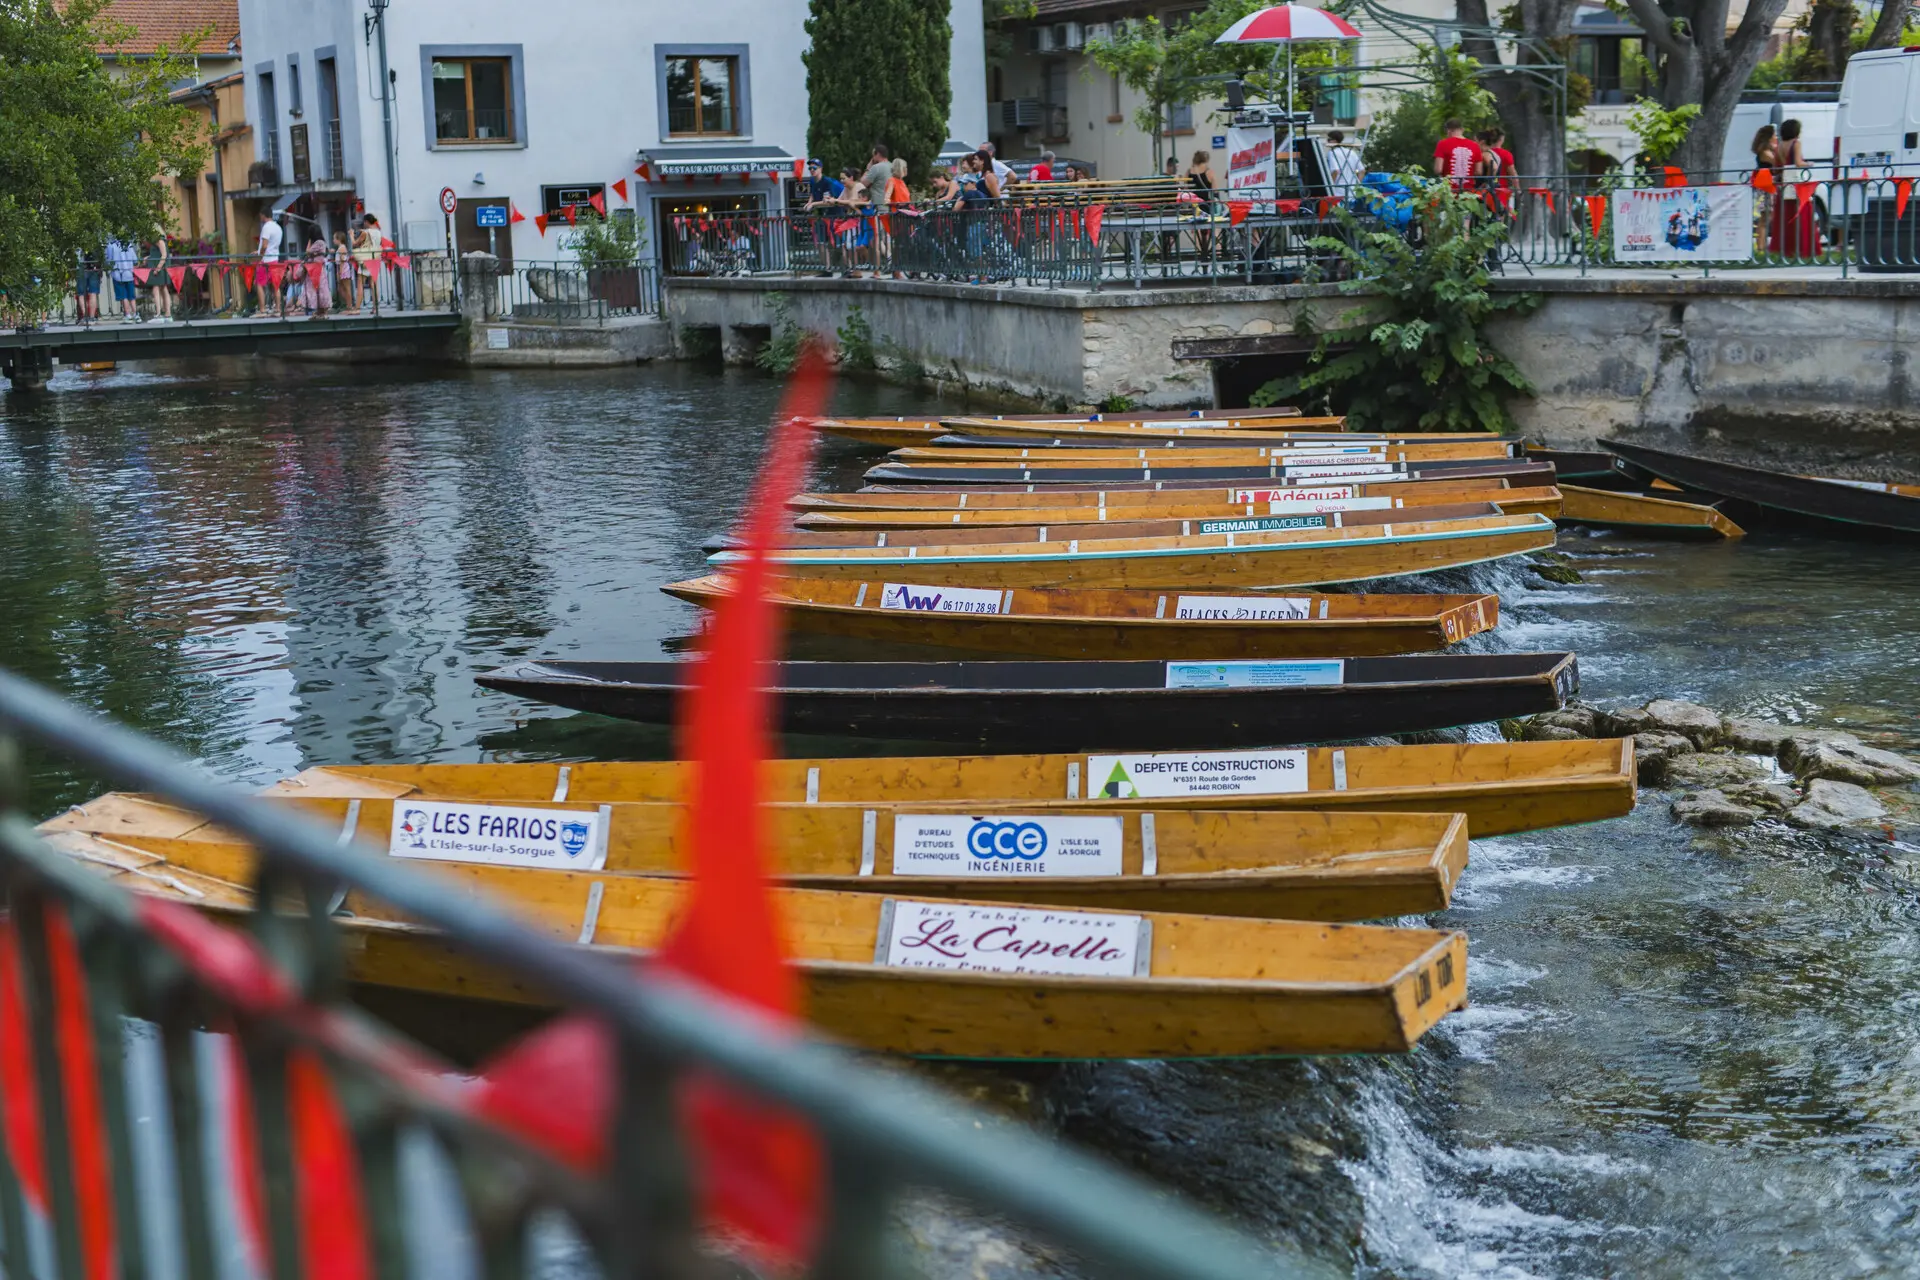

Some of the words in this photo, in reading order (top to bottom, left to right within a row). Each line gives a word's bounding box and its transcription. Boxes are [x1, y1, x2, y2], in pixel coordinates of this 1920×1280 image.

[750, 162, 792, 172] PLANCHE
[1292, 458, 1335, 466] TORRECILLAS
[1336, 456, 1377, 465] CHRISTOPHE
[1270, 488, 1348, 501] Adéquat
[1203, 519, 1259, 533] GERMAIN
[1262, 516, 1323, 530] IMMOBILIER
[943, 600, 952, 611] 06
[955, 601, 964, 612] 17
[965, 602, 974, 612] 01
[975, 602, 985, 613] 28
[987, 603, 996, 614] 98
[1180, 608, 1228, 620] BLACKS
[1134, 761, 1189, 774] DEPEYTE
[1191, 759, 1295, 772] CONSTRUCTIONS
[1221, 774, 1230, 782] de
[1231, 774, 1257, 782] Gordes
[1212, 783, 1240, 791] ROBION
[432, 812, 470, 835] LES
[478, 815, 557, 841] FARIOS
[918, 828, 952, 836] BUREAU
[915, 840, 954, 848] D'ETUDES
[1060, 838, 1082, 847] L'ISLE
[1083, 838, 1099, 847] SUR
[430, 839, 556, 858] L'Isle-sur-la-Sorgue
[1058, 848, 1069, 856] LA
[1070, 848, 1101, 857] SORGUE
[908, 852, 960, 861] TECHNIQUES
[920, 907, 955, 918] Bar
[1043, 914, 1118, 928] Presse
[899, 918, 967, 959] La
[973, 924, 1127, 963] Capello
